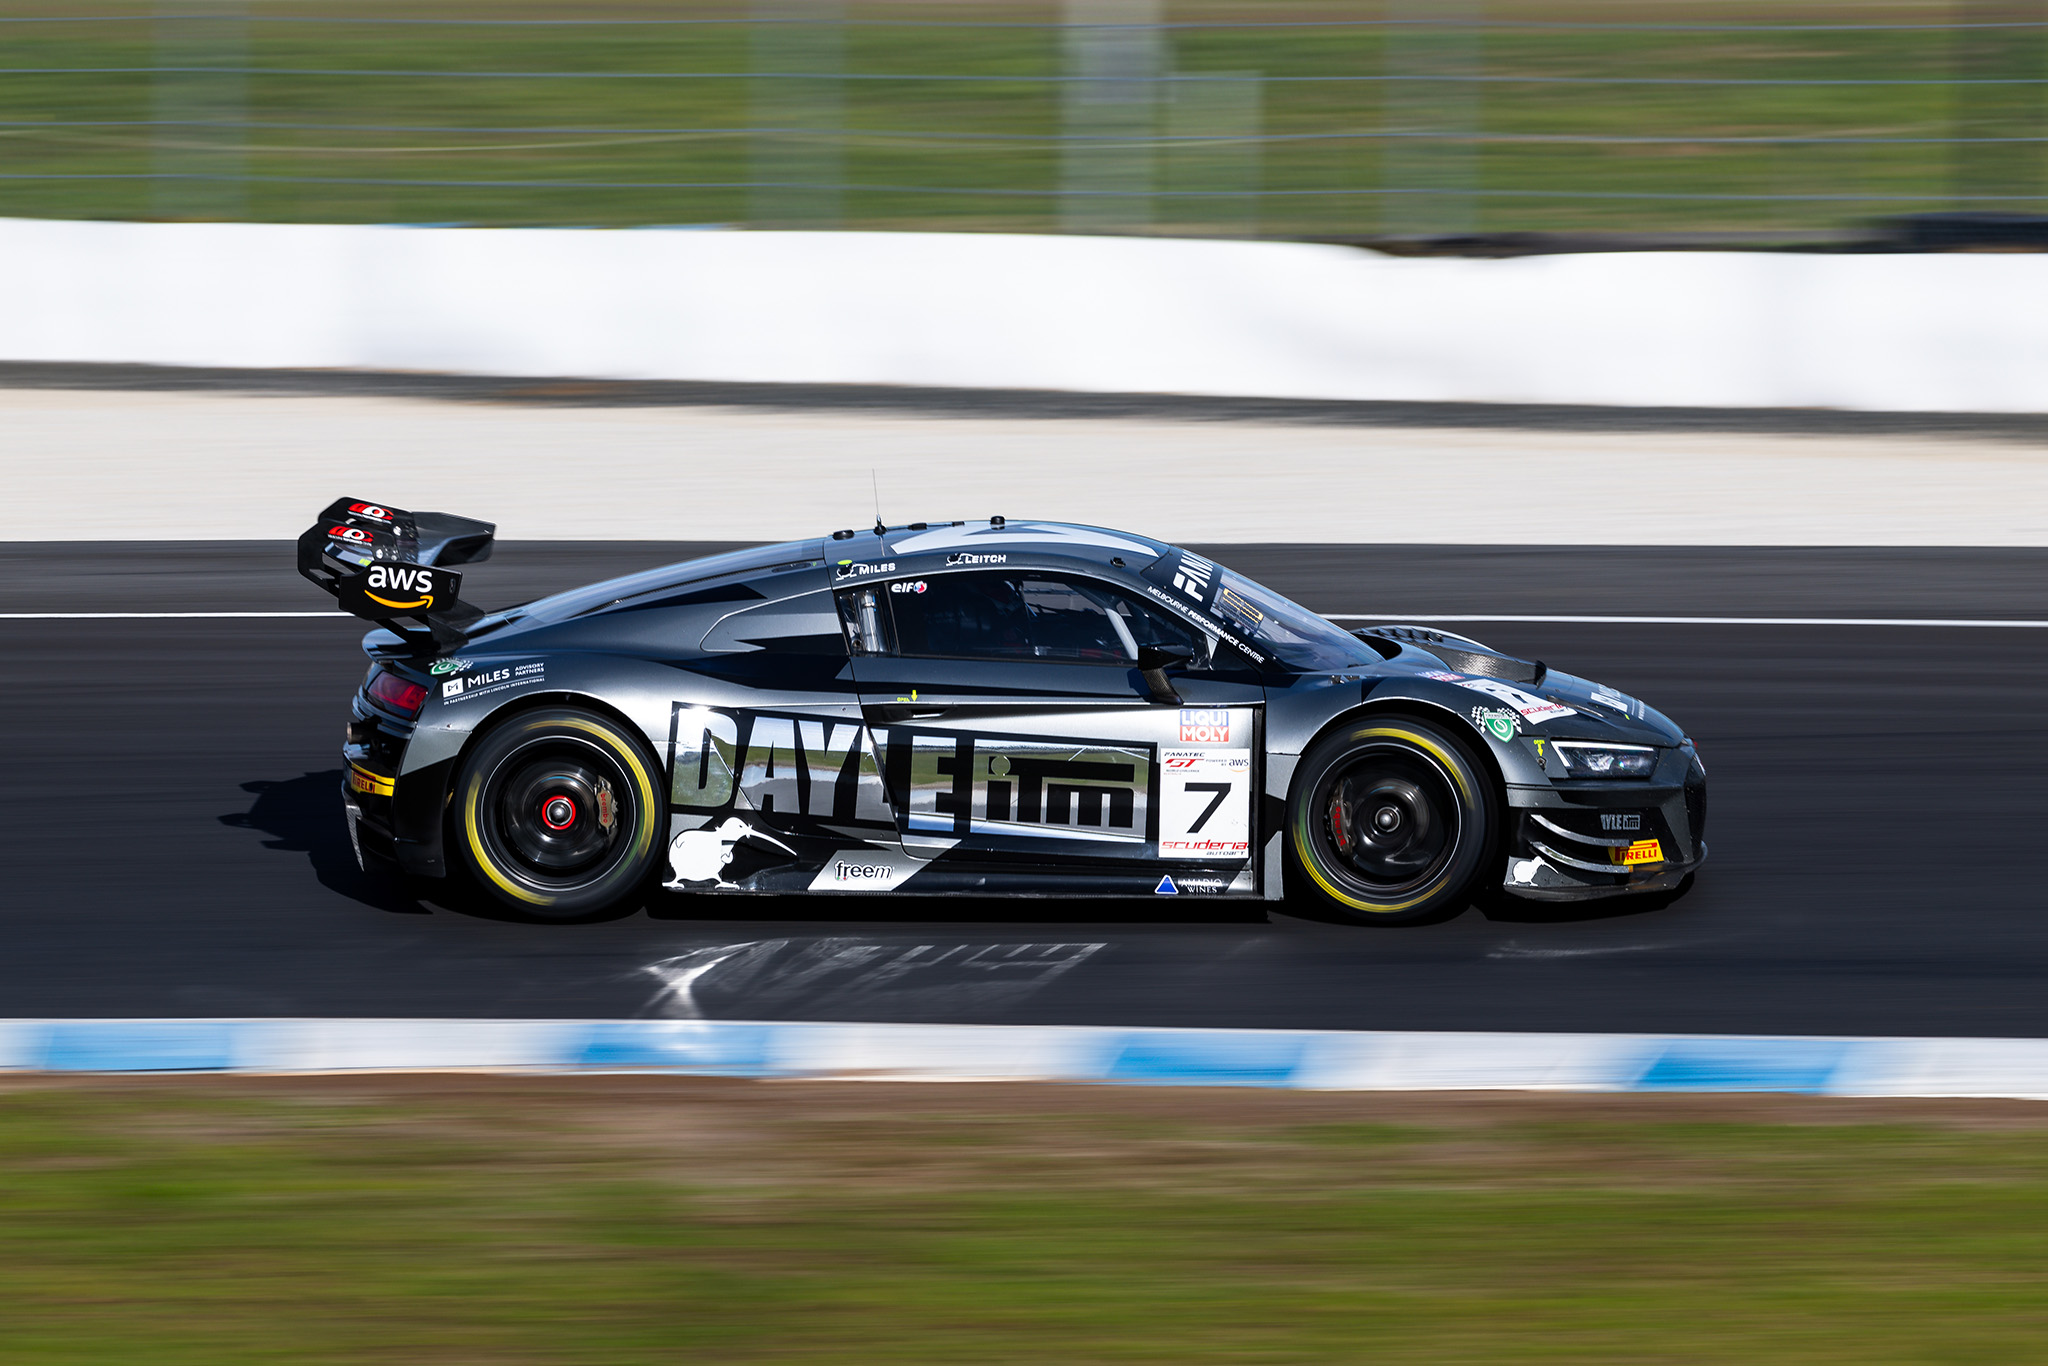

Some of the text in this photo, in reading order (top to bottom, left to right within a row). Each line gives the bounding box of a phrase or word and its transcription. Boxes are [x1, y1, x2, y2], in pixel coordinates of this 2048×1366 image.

[965, 554, 1006, 565] LEITCH
[858, 563, 896, 575] MILES
[367, 565, 433, 593] aws
[890, 581, 915, 593] elf
[1147, 585, 1265, 664] MELBOURNE PERFORMANCE CENTRE
[514, 662, 545, 671] ADVISORY
[515, 667, 545, 676] PARTNERS
[467, 668, 511, 688] MILES
[1181, 710, 1228, 726] LIQUI
[1181, 726, 1229, 742] MOLY
[671, 707, 957, 832] DAYLE
[1229, 758, 1249, 767] aws
[1183, 782, 1232, 834] 7
[1161, 839, 1249, 851] scuderia
[836, 861, 892, 880] freem
[1187, 886, 1218, 894] WINES
